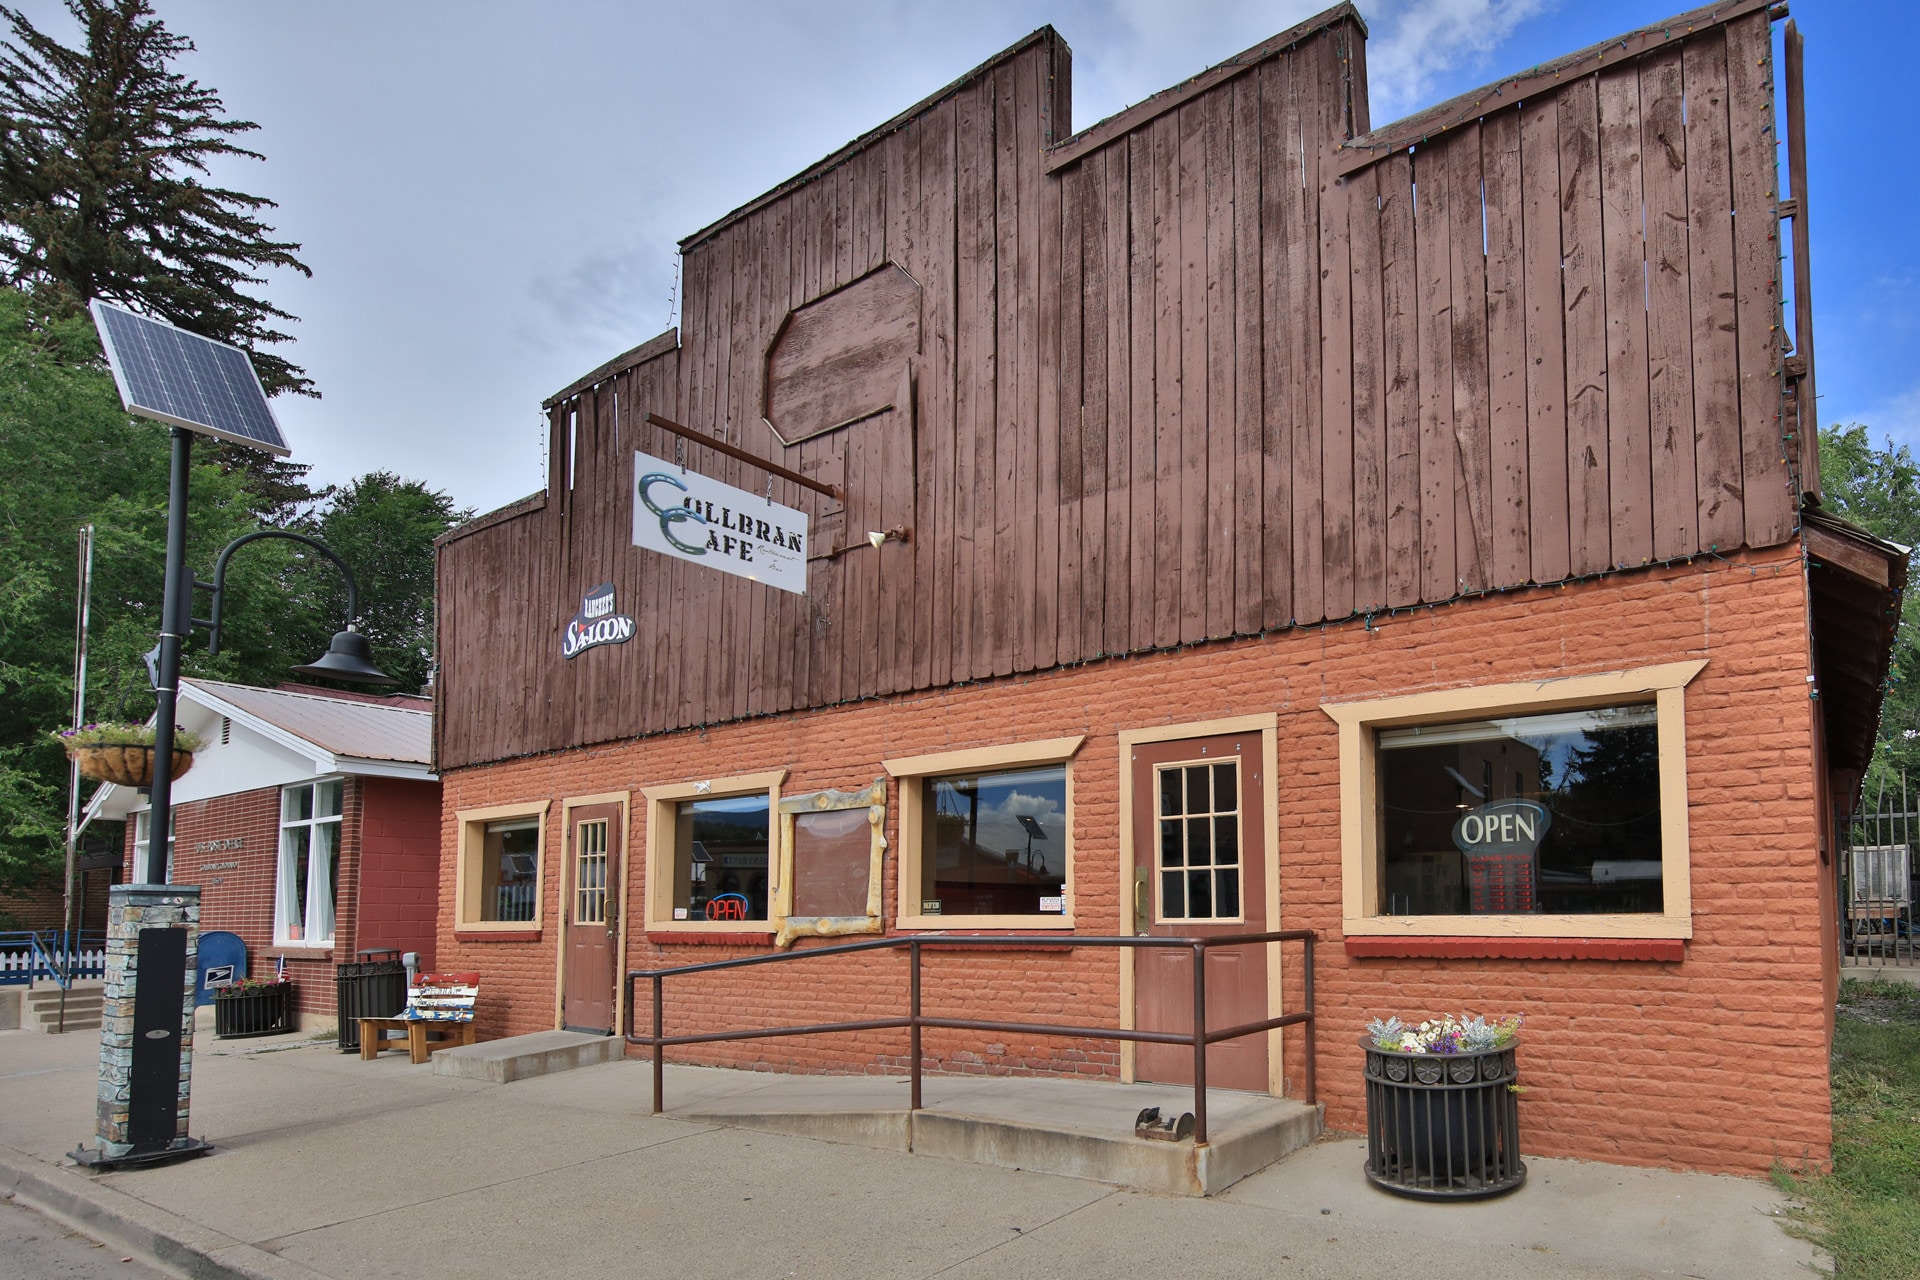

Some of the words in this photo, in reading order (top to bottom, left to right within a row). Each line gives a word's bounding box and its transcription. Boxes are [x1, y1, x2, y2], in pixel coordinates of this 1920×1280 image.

[660, 506, 754, 563] CAFE
[563, 616, 633, 656] SALOON
[1461, 812, 1536, 844] OPEN
[705, 899, 747, 921] OPEN
